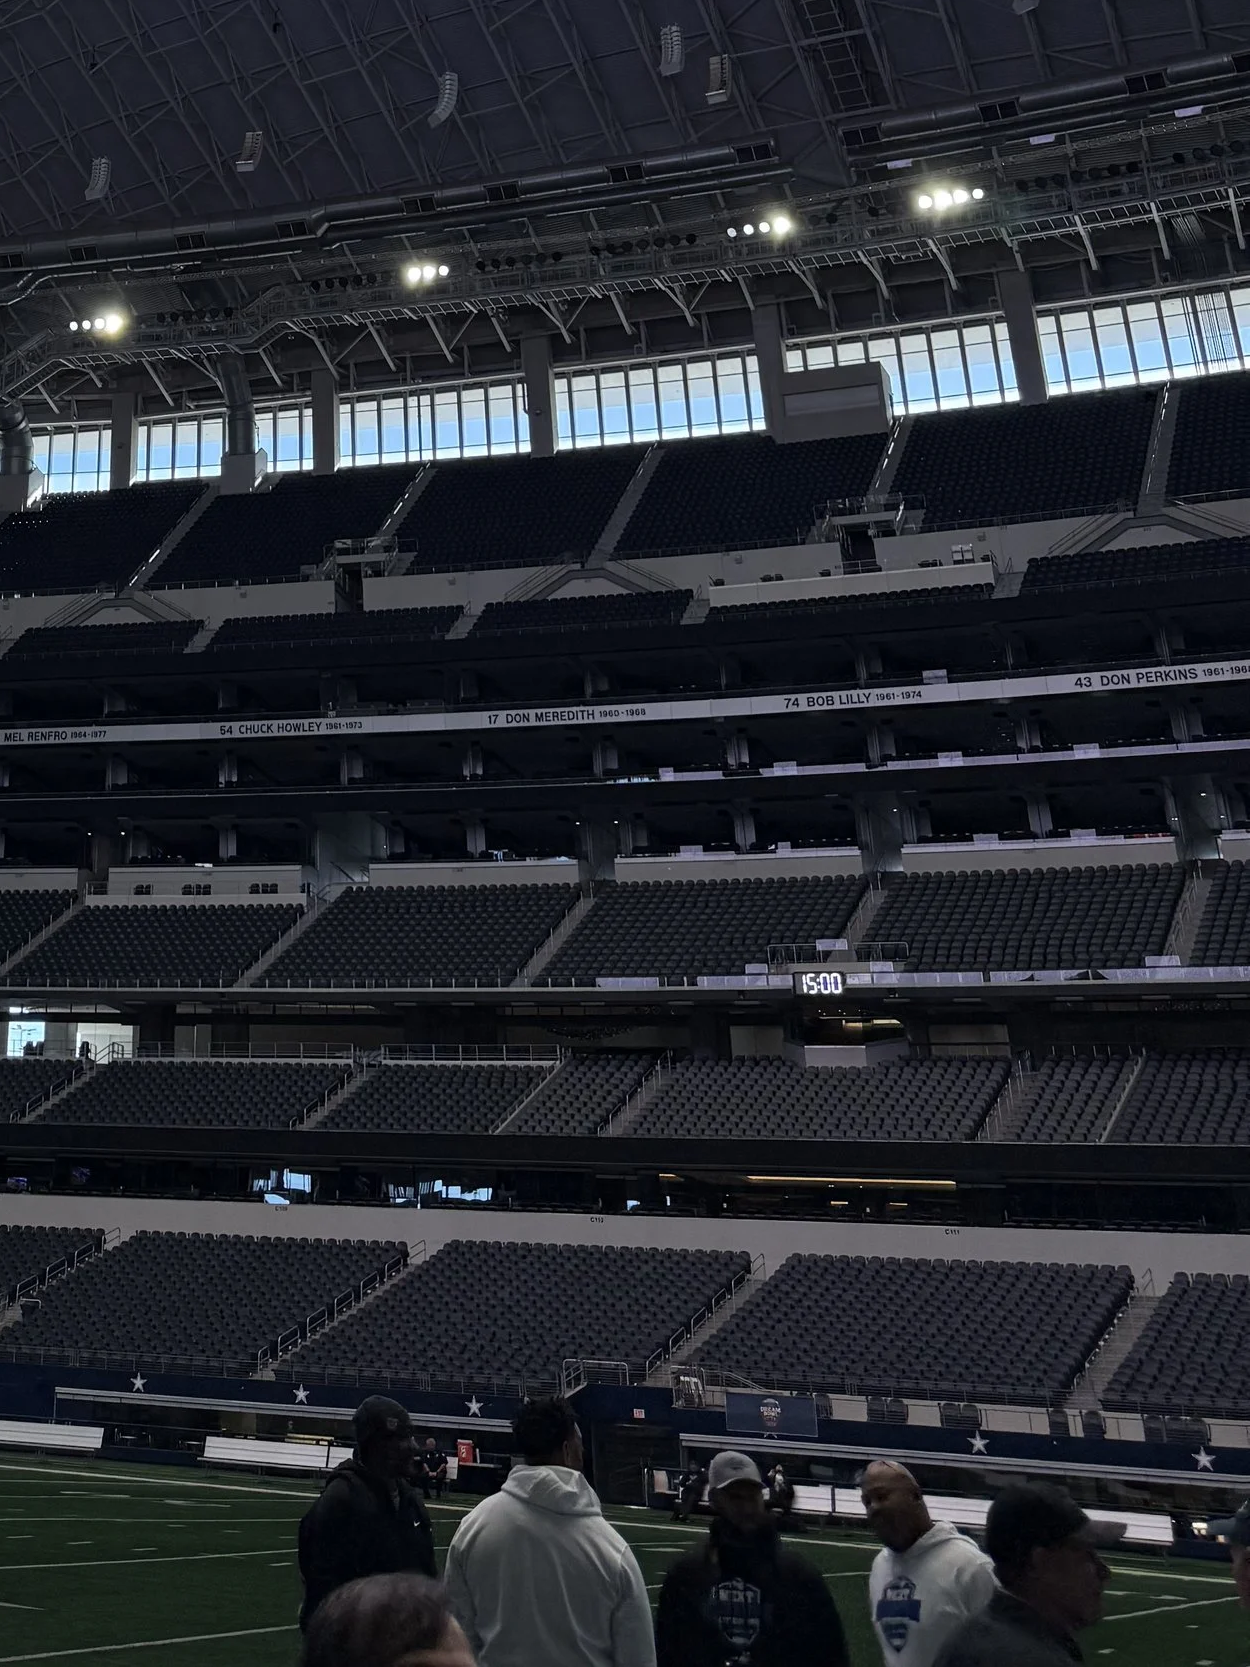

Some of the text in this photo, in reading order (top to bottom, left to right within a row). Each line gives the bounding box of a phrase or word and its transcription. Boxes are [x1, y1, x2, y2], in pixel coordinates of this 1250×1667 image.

[1074, 676, 1092, 688] 43
[1100, 673, 1130, 686] DON
[1136, 668, 1198, 684] PERKINS
[784, 690, 922, 709] 74 BOB LILLY 1961-1974
[487, 708, 646, 725] 17 DON MEREDITH 1960-1968
[4, 732, 24, 742] MEL
[27, 731, 68, 741] RENFRO
[220, 725, 233, 735] 54
[238, 723, 274, 735] CHUCK
[277, 721, 323, 733] HOWLEY
[802, 972, 843, 995] 15:00
